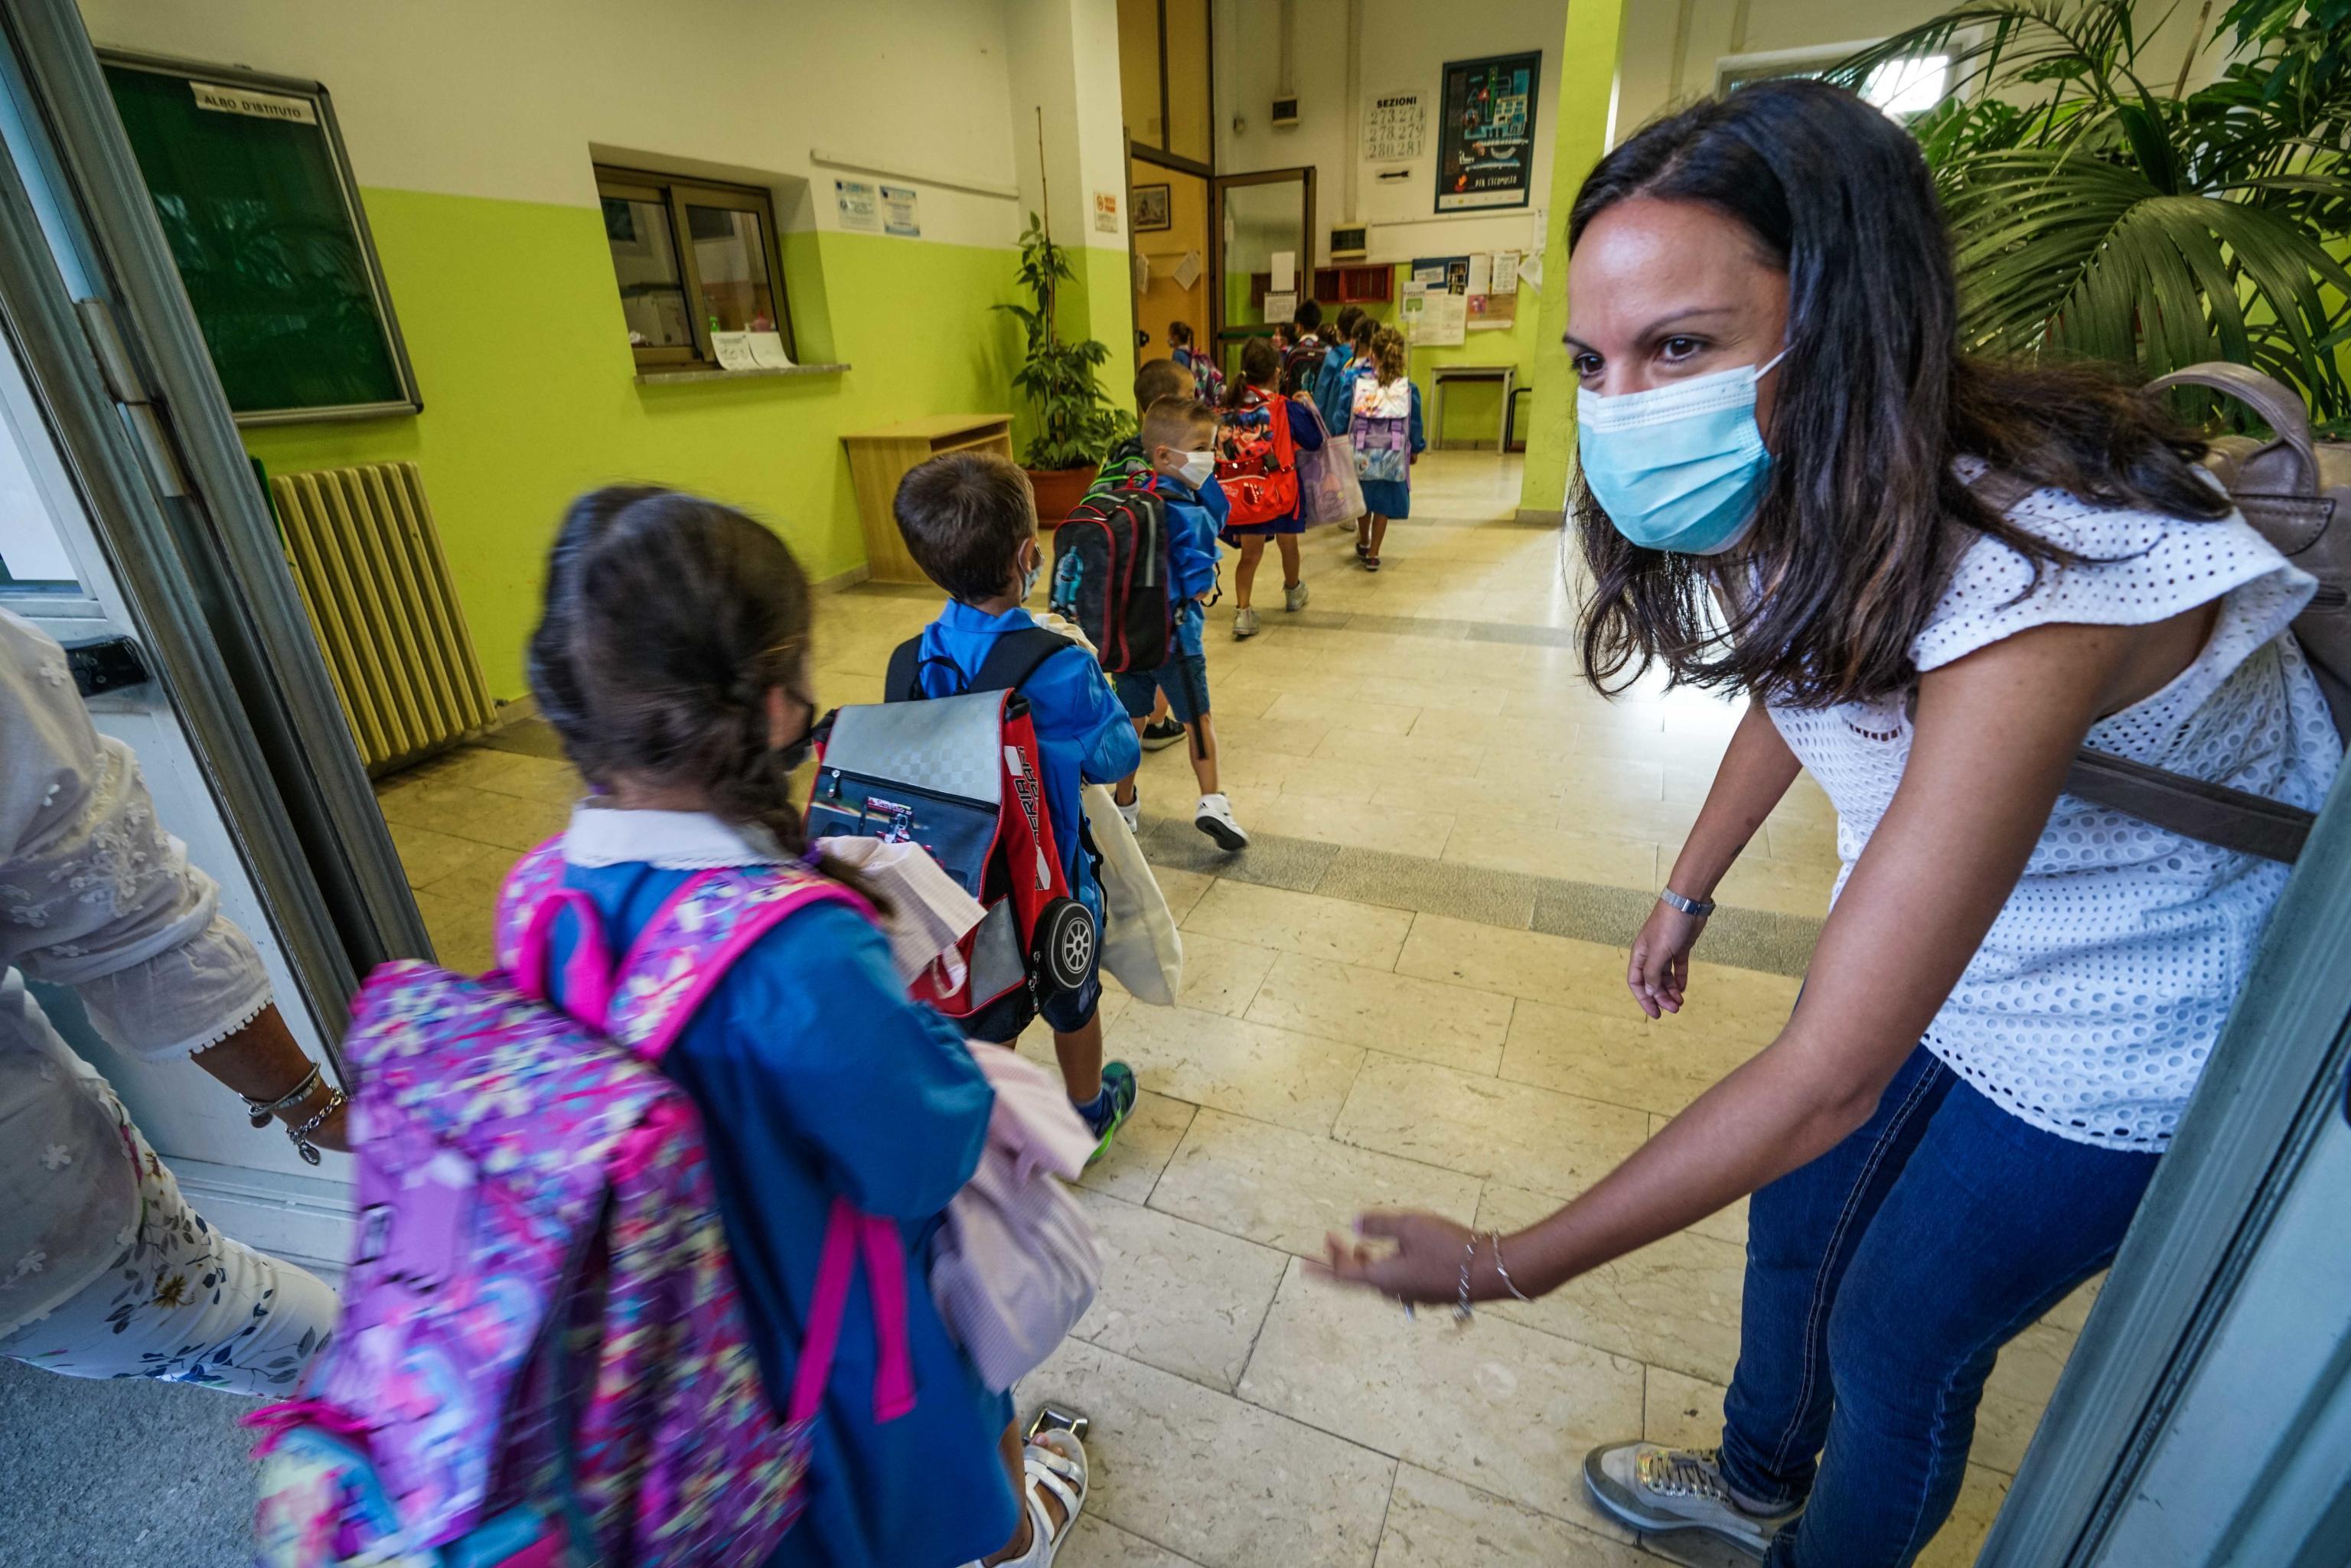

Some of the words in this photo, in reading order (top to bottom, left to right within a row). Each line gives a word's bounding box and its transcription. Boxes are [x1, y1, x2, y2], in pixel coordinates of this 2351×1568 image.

[204, 96, 236, 109] ALBO
[242, 101, 301, 118] D'ISTITUTO
[1377, 96, 1417, 108] SEZIONI
